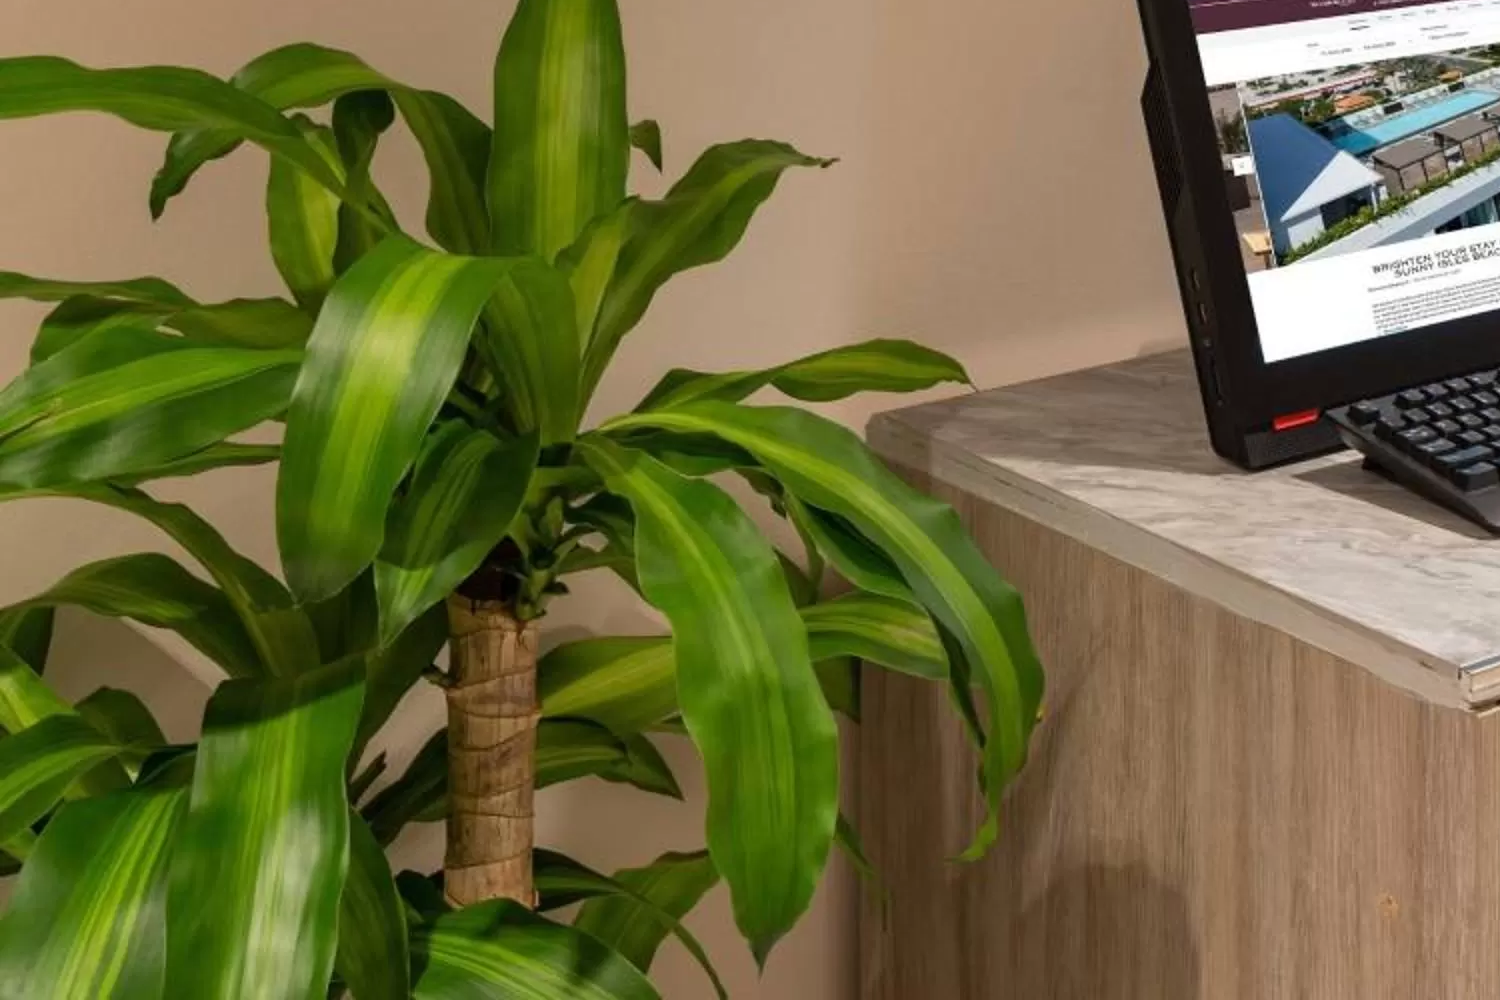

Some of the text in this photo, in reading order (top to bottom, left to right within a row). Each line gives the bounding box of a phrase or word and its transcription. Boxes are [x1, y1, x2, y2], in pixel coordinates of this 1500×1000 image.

[1372, 254, 1431, 274] BRIGHTEN
[1434, 245, 1467, 260] YOUR
[1469, 239, 1496, 253] STAY
[1394, 263, 1434, 278] SUNNY
